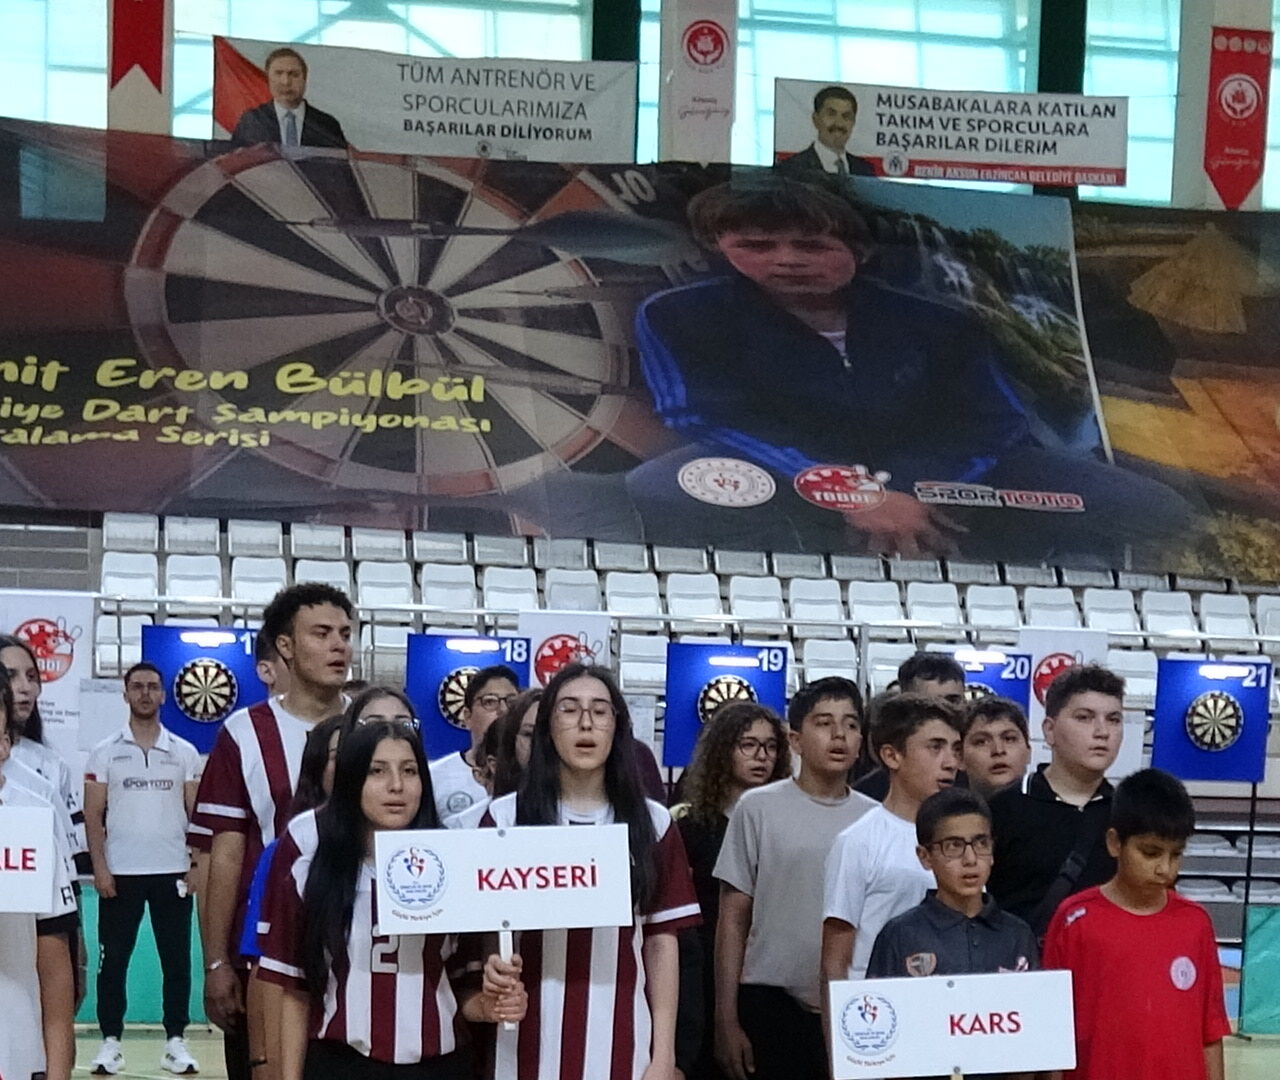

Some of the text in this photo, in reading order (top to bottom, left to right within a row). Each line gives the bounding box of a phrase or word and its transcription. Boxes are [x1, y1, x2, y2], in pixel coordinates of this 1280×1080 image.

[396, 61, 596, 91] TÜM ANTRENÖR VE
[403, 94, 588, 120] SPORCULARIMIZA
[1037, 101, 1117, 118] KATILAN
[403, 119, 593, 141] BAŞARILAR DİLİYORUM
[876, 113, 1090, 137] TAKIM VE SPORCULARA
[876, 132, 979, 151] BAŞARILAR
[95, 358, 249, 391] Eren
[275, 362, 486, 402] Bülbül
[82, 398, 195, 424] Dart
[155, 425, 270, 448] Serisi
[501, 637, 528, 663] 18
[757, 648, 783, 672] 19
[1001, 656, 1030, 680] 20
[1241, 665, 1268, 688] 21
[476, 857, 598, 892] KAYSERİ
[948, 1010, 1022, 1036] KARS
